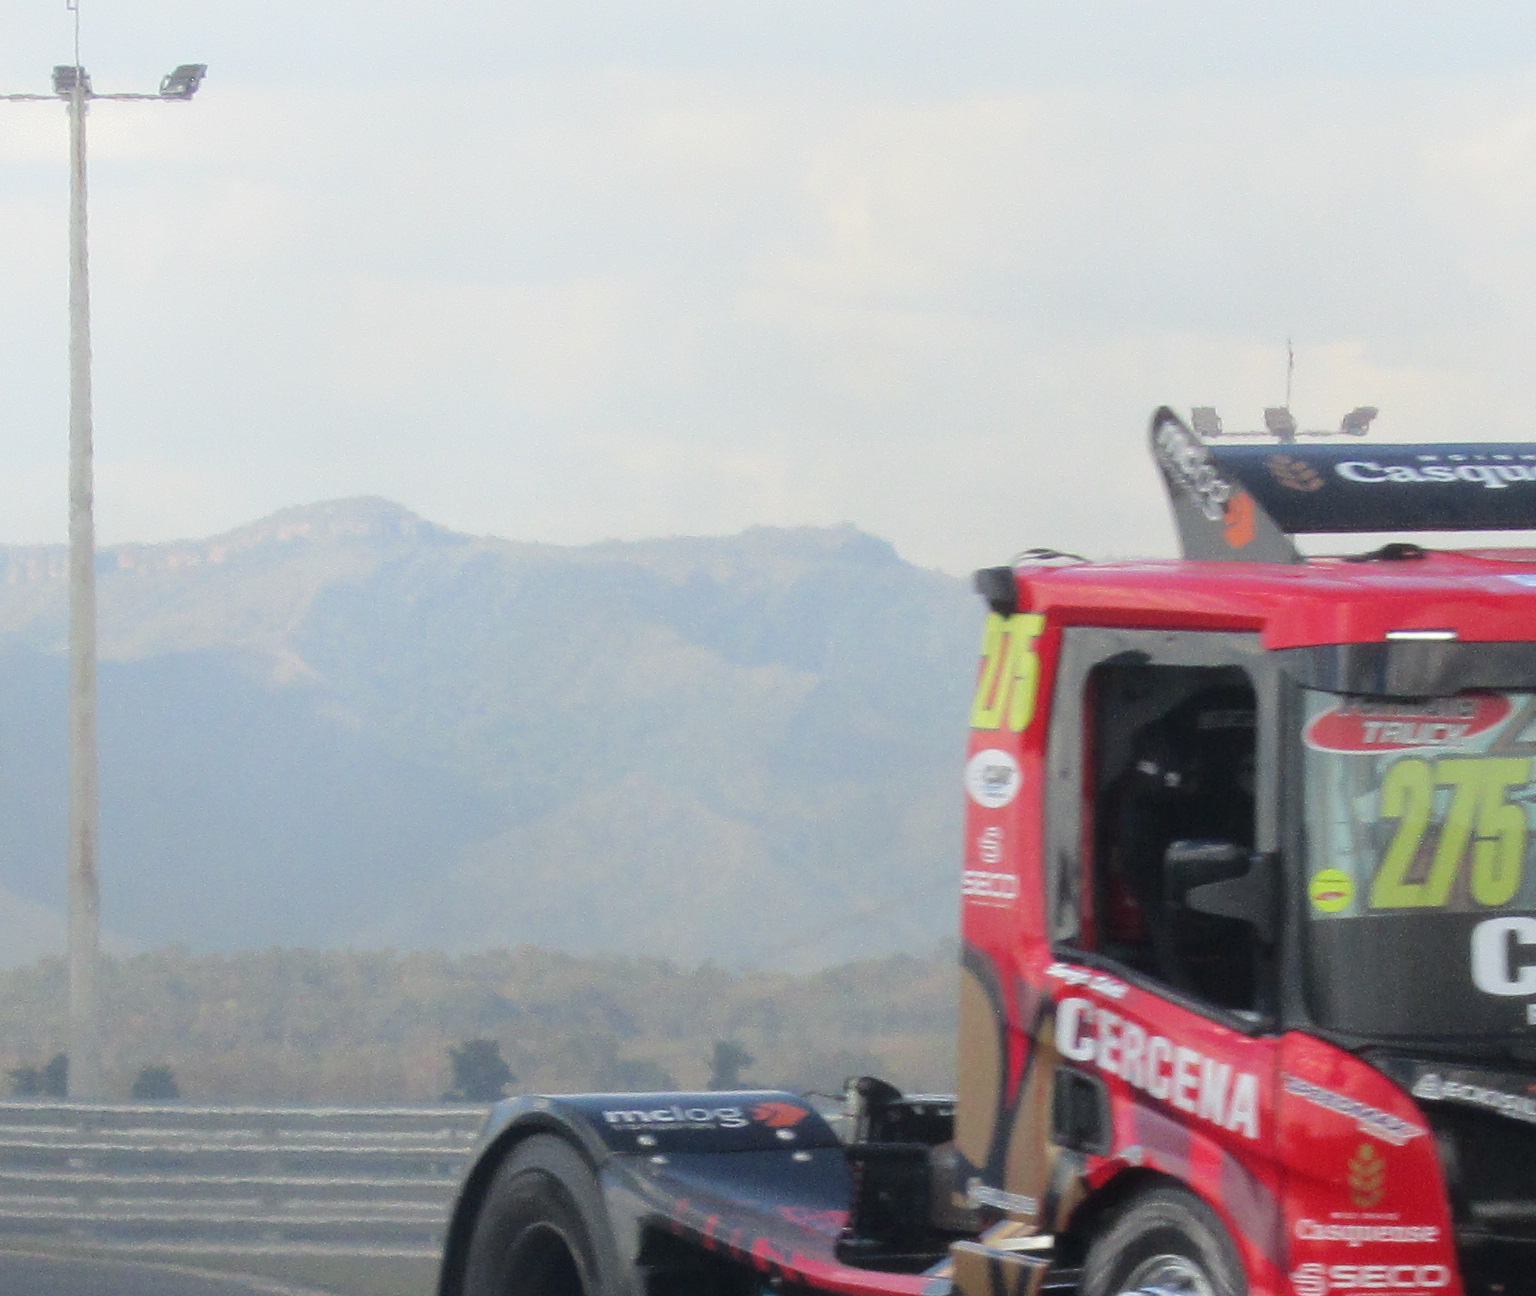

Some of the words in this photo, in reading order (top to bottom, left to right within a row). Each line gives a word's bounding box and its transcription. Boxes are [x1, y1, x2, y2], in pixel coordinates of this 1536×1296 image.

[1369, 757, 1533, 909] 275
[1055, 997, 1260, 1140] CERCENA
[1327, 1264, 1453, 1289] SECO
